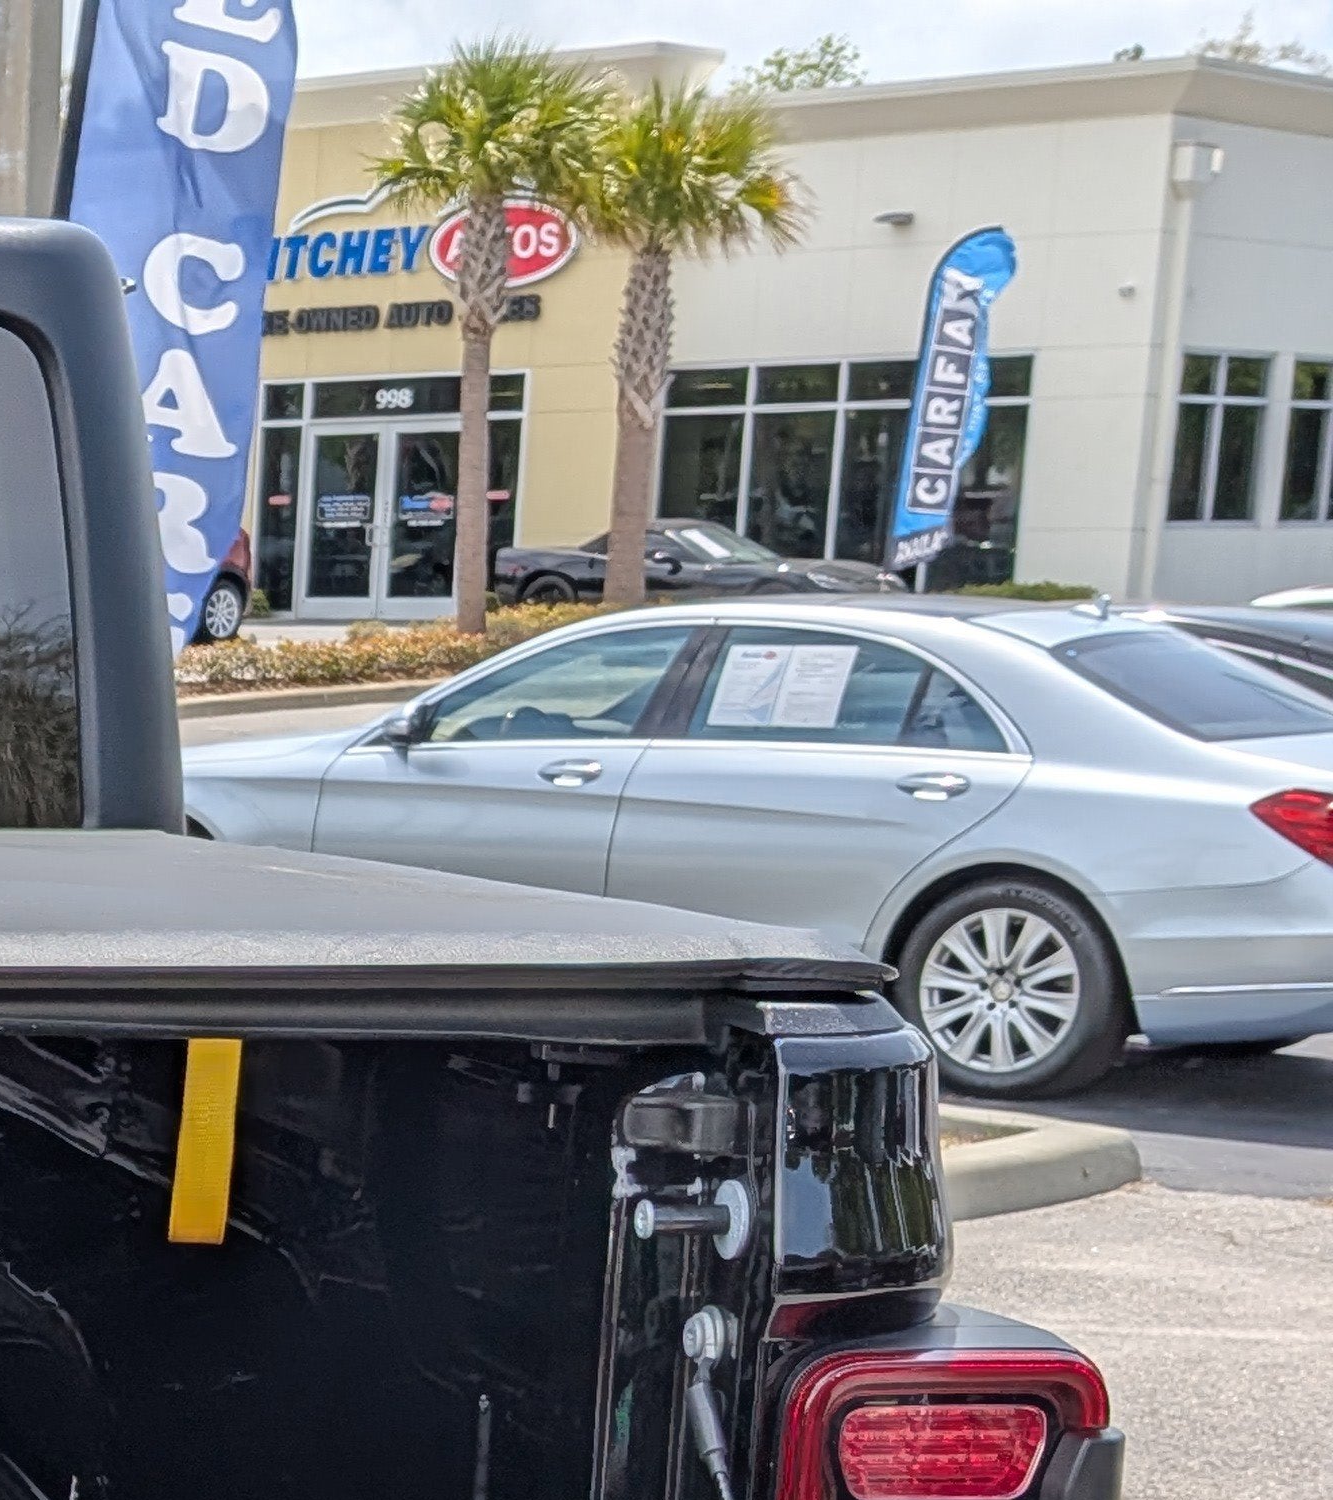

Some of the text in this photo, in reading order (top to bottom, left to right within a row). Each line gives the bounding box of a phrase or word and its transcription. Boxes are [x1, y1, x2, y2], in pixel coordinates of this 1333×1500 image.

[267, 225, 430, 281] ITCHEY
[384, 300, 454, 329] AUTO
[375, 388, 414, 410] 998
[915, 266, 984, 507] CARFAX
